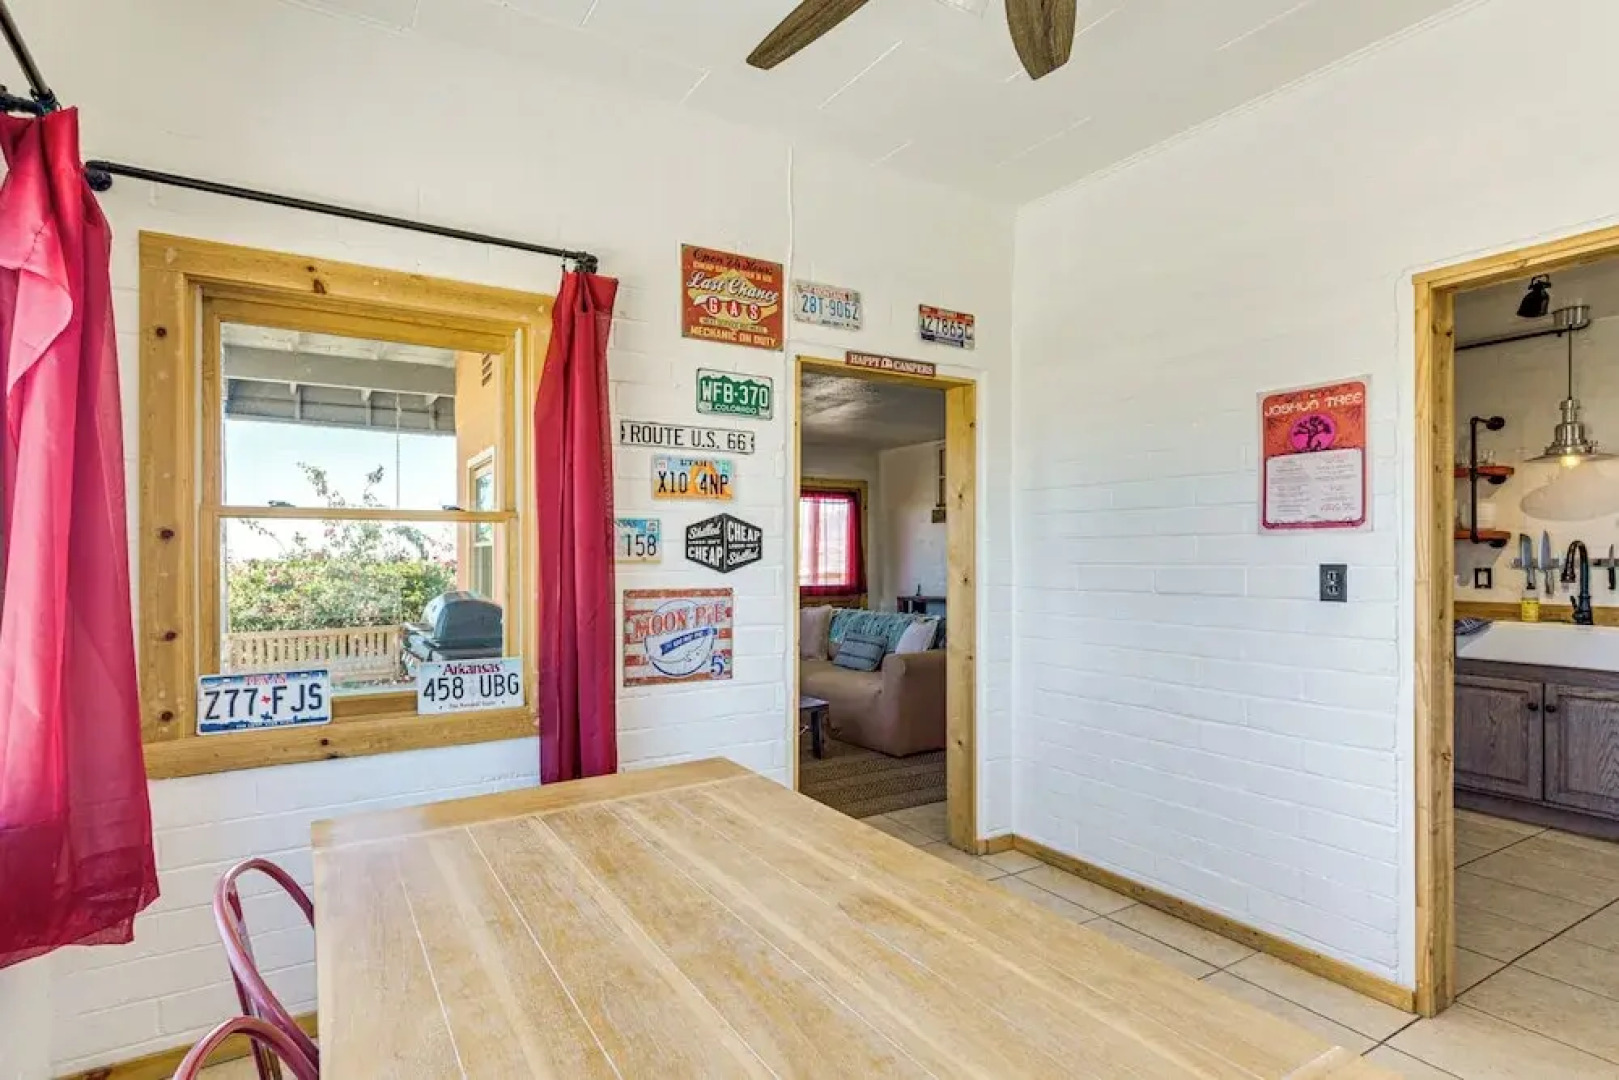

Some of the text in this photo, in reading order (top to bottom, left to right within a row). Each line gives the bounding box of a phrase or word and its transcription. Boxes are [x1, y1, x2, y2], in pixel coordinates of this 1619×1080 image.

[686, 270, 725, 293] Last
[728, 278, 779, 301] Chance
[690, 325, 737, 341] MECHANIC
[739, 332, 751, 343] ON
[754, 335, 776, 347] DUTY
[851, 354, 881, 368] HAPPY
[716, 404, 756, 415] COLORADO
[1323, 391, 1363, 409] TREE
[631, 425, 746, 451] ROUTE U.S. 66
[700, 473, 729, 495] 4NP
[728, 520, 760, 542] CHEAP
[626, 533, 656, 557] 158
[688, 545, 723, 567] CHEAP
[246, 674, 287, 686] TEXAS
[444, 663, 501, 675] Arkansas
[423, 672, 519, 702] 458 UBG
[204, 682, 322, 720] Z77 FJS
